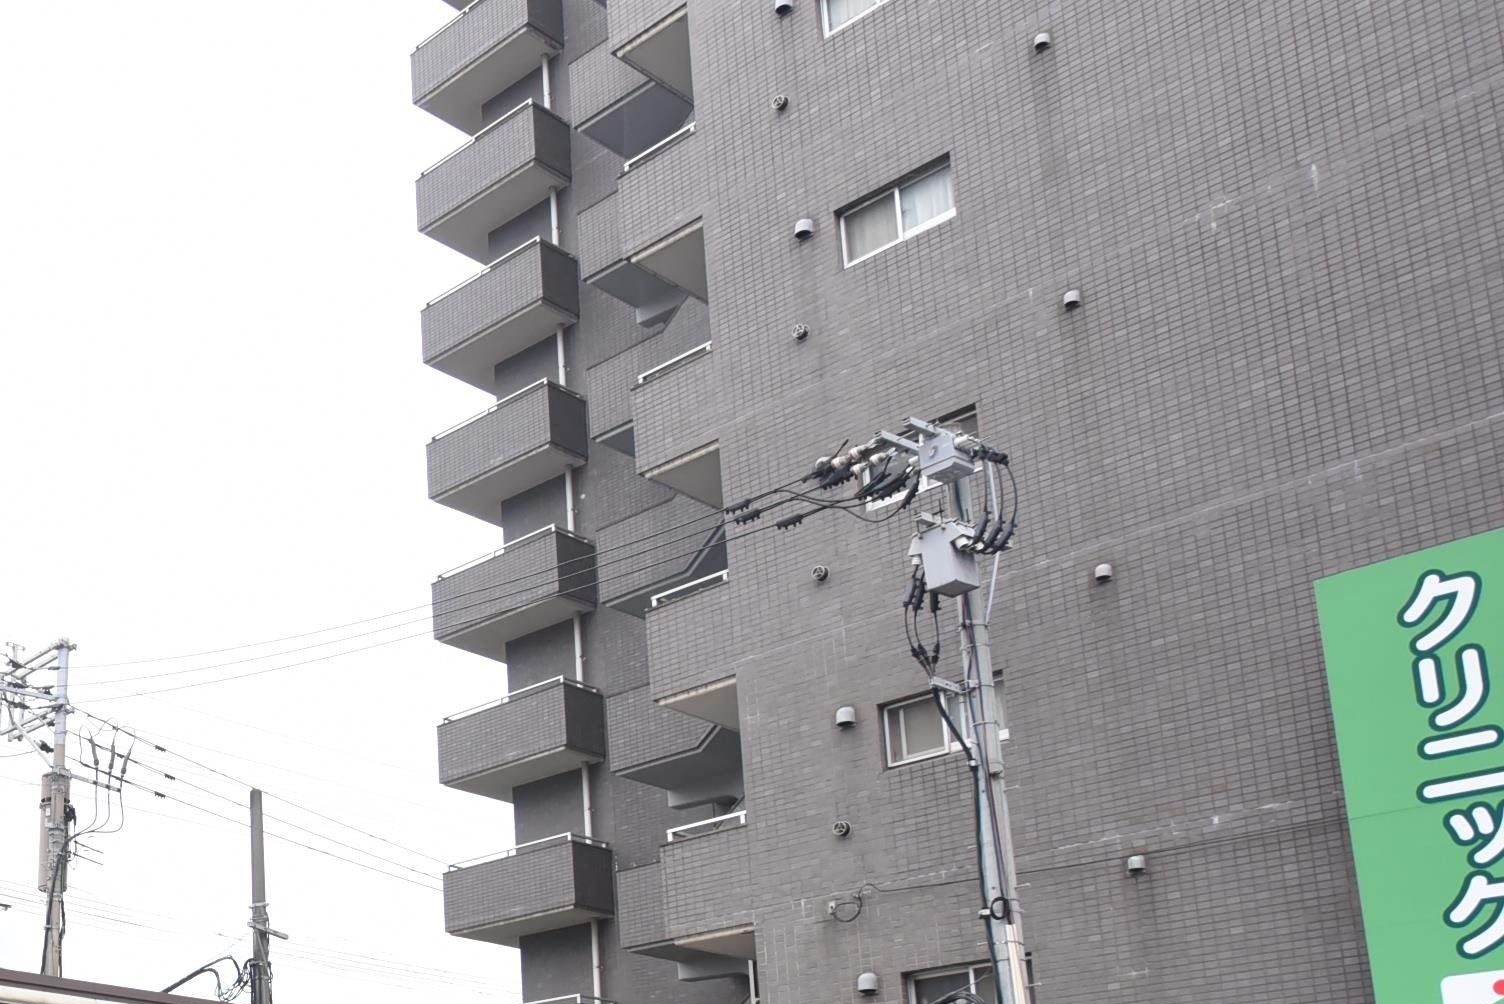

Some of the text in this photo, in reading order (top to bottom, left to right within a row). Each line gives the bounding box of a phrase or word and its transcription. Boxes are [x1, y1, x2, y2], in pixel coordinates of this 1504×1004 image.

[1397, 570, 1504, 960] クリニック
